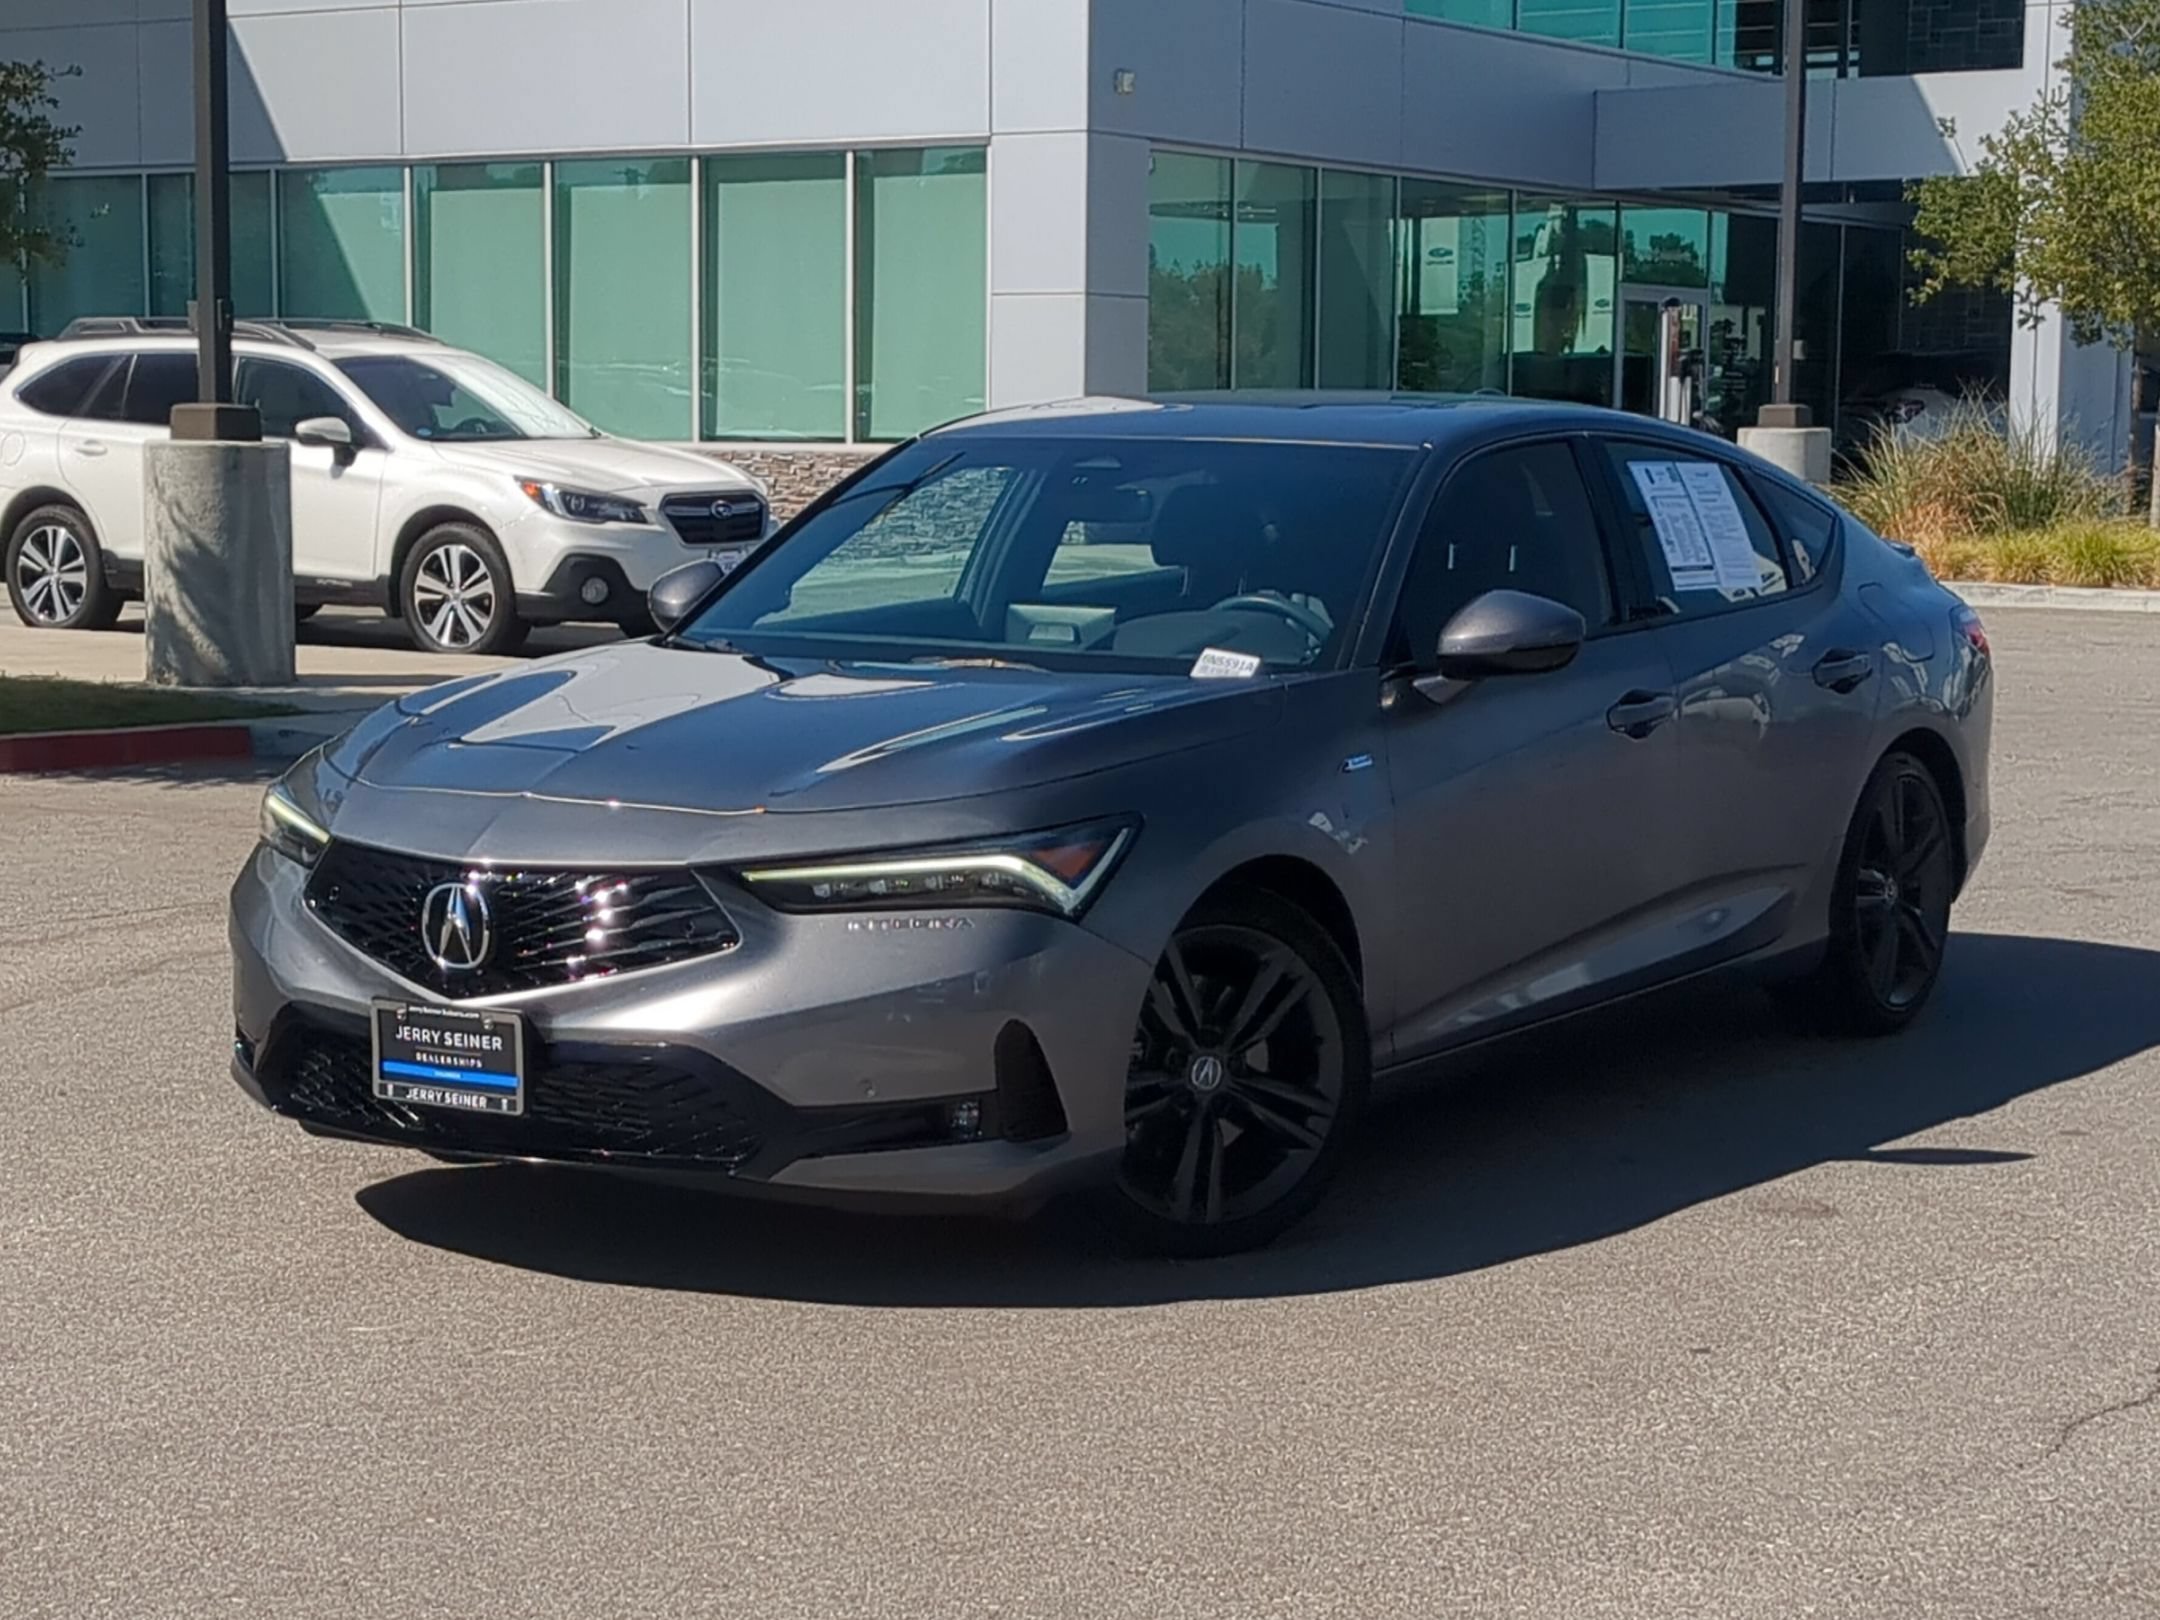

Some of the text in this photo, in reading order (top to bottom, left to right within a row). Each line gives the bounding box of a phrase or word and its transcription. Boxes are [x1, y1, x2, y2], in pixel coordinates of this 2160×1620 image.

[395, 1025, 503, 1051] JERRY SEINER
[415, 1052, 483, 1068] DEALERSHIPS
[406, 1087, 488, 1108] JERRY SEINER
